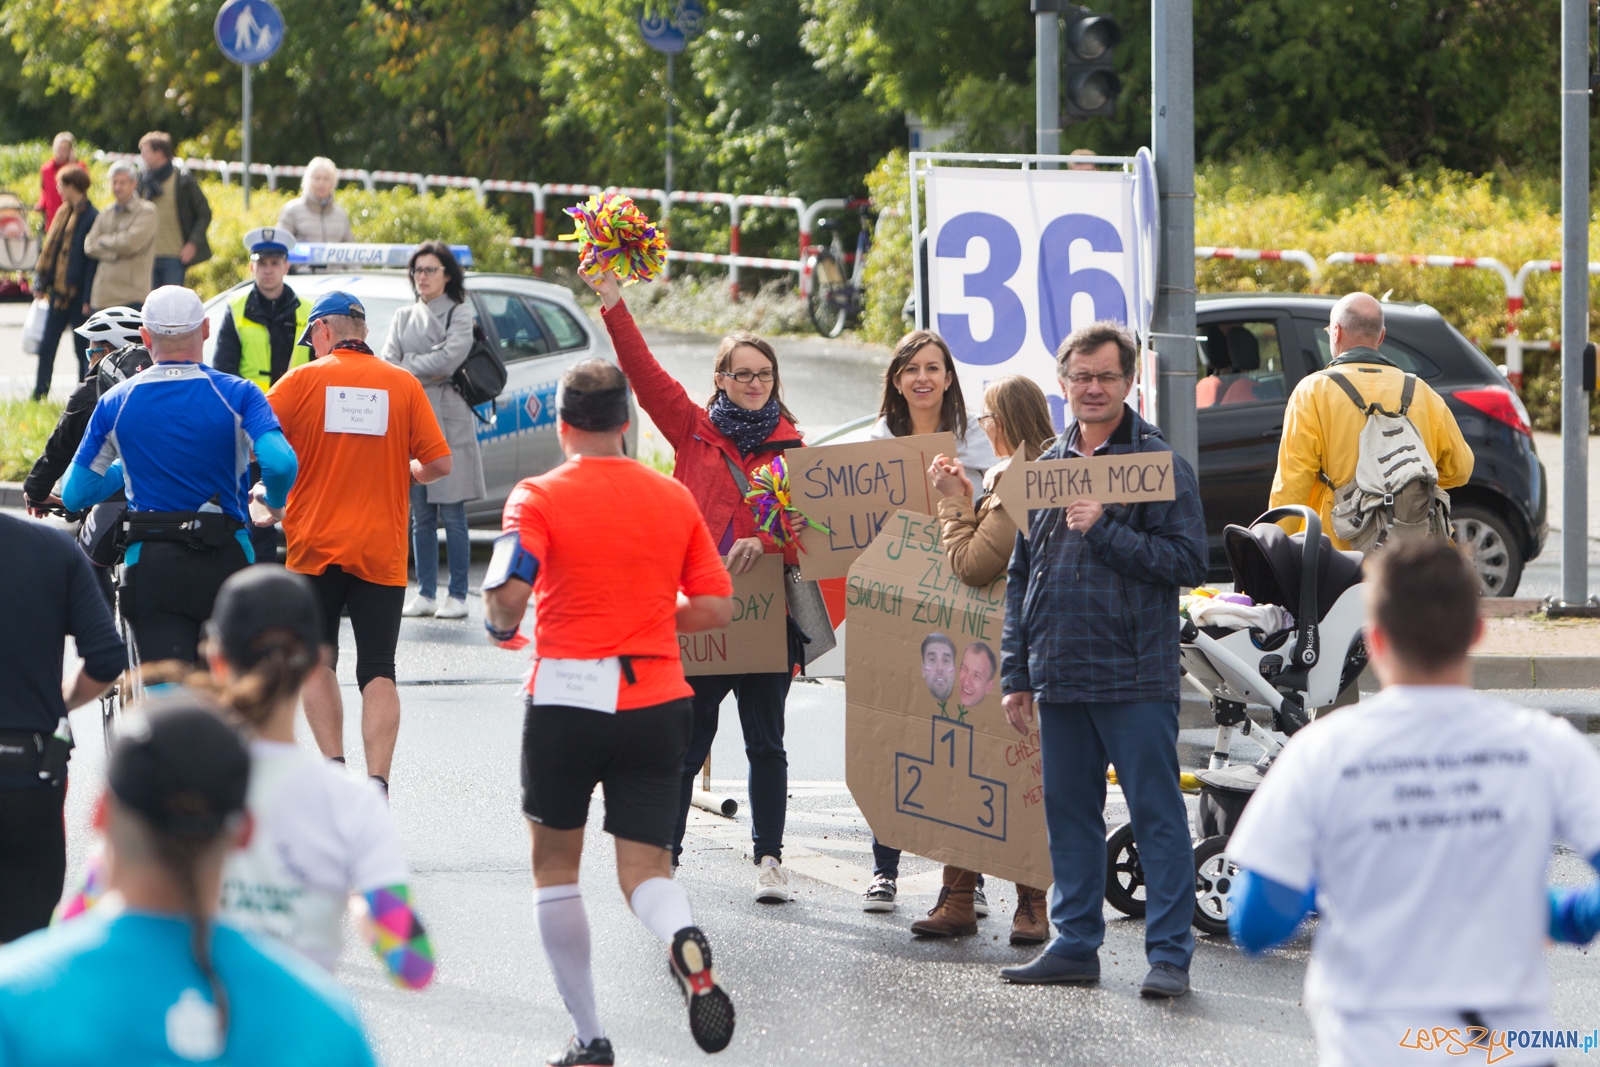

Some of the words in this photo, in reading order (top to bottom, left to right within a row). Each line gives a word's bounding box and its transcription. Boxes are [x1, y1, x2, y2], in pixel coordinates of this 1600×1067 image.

[326, 248, 383, 262] POLICJA
[935, 211, 1128, 366] 36
[363, 407, 373, 415] dla
[804, 459, 906, 506] ŚMIGAJ
[1025, 468, 1093, 504] PIĄTKA
[1108, 464, 1170, 493] MOCY
[886, 515, 948, 561] JEŚL
[846, 575, 904, 617] SWOICH
[961, 602, 998, 641] NIE
[678, 633, 727, 662] RUN
[1306, 624, 1315, 649] kiddy
[940, 728, 955, 768] 1
[1005, 729, 1041, 767] CHŁO
[902, 765, 925, 810] 2
[977, 785, 995, 828] 3
